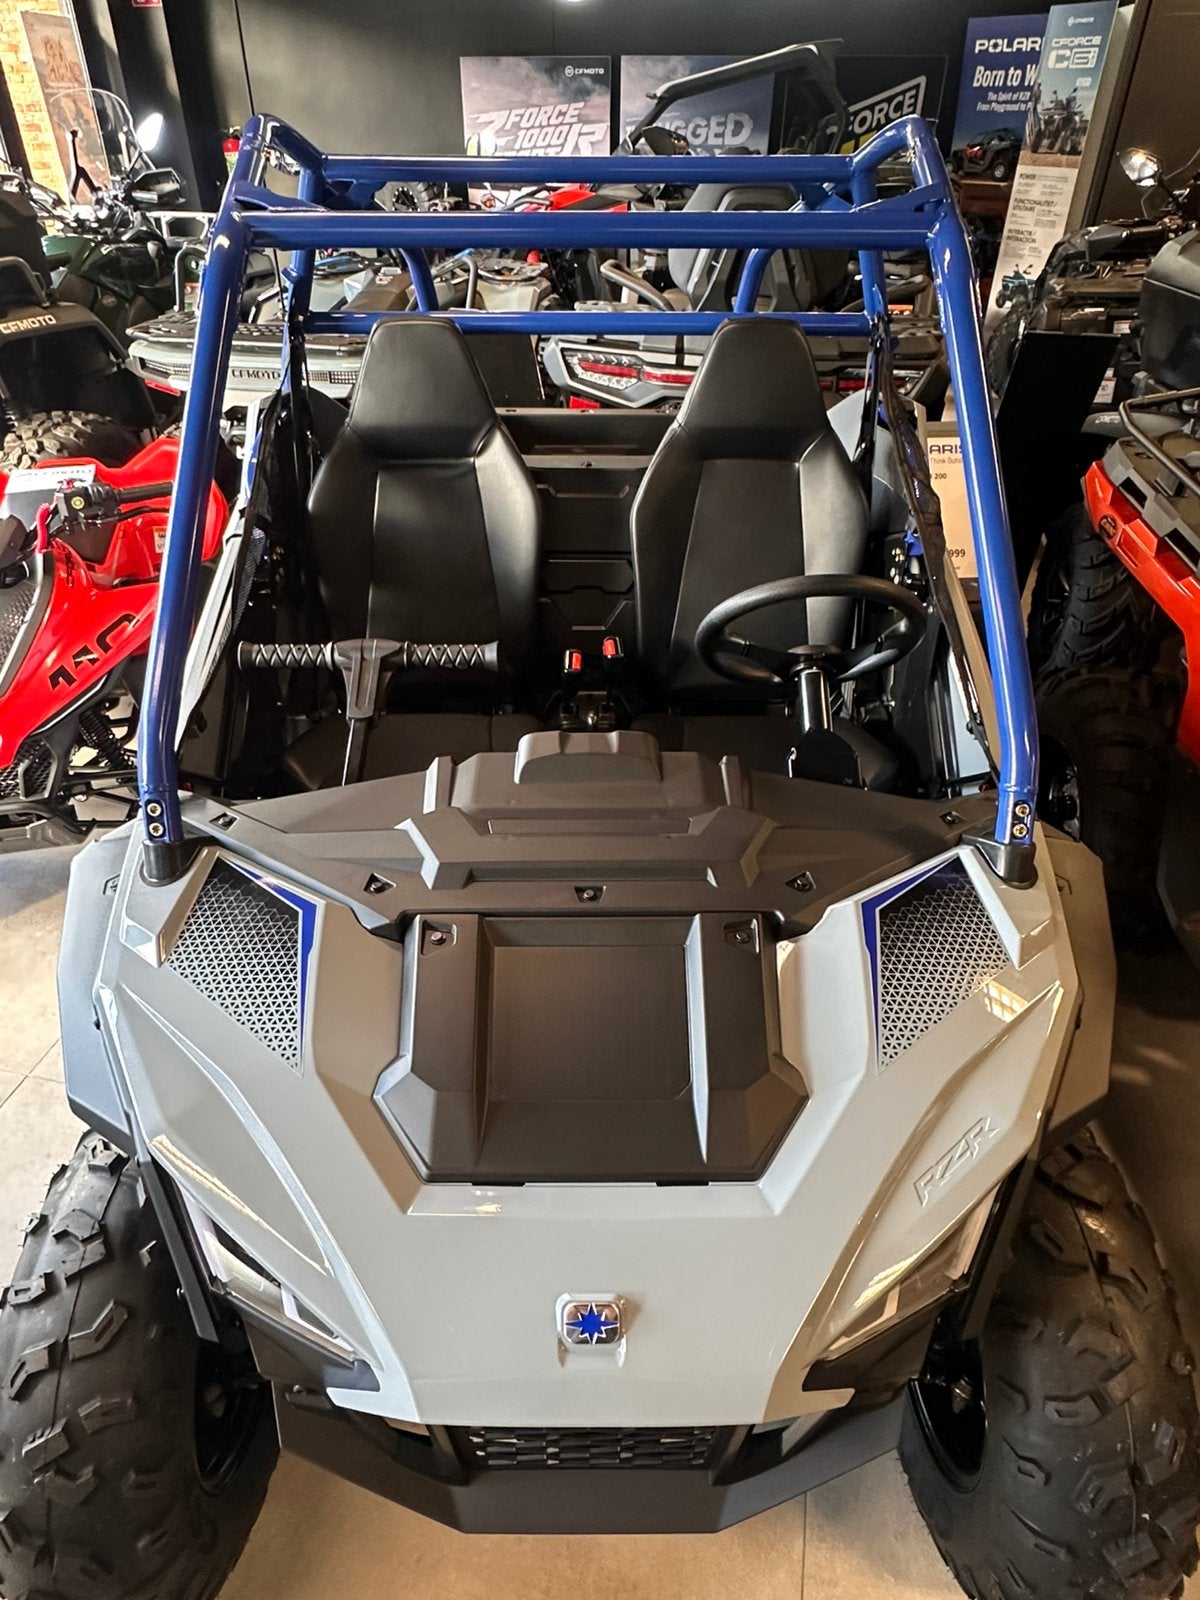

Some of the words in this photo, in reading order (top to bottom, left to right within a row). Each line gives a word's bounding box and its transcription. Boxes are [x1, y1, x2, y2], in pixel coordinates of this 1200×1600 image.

[574, 66, 604, 75] CFMOTO
[972, 65, 1005, 87] Born
[1007, 66, 1022, 87] to
[514, 126, 567, 150] 1000
[0, 314, 57, 334] CFMOTO
[232, 369, 281, 380] CFMOTO
[913, 1116, 1000, 1208] RZR
